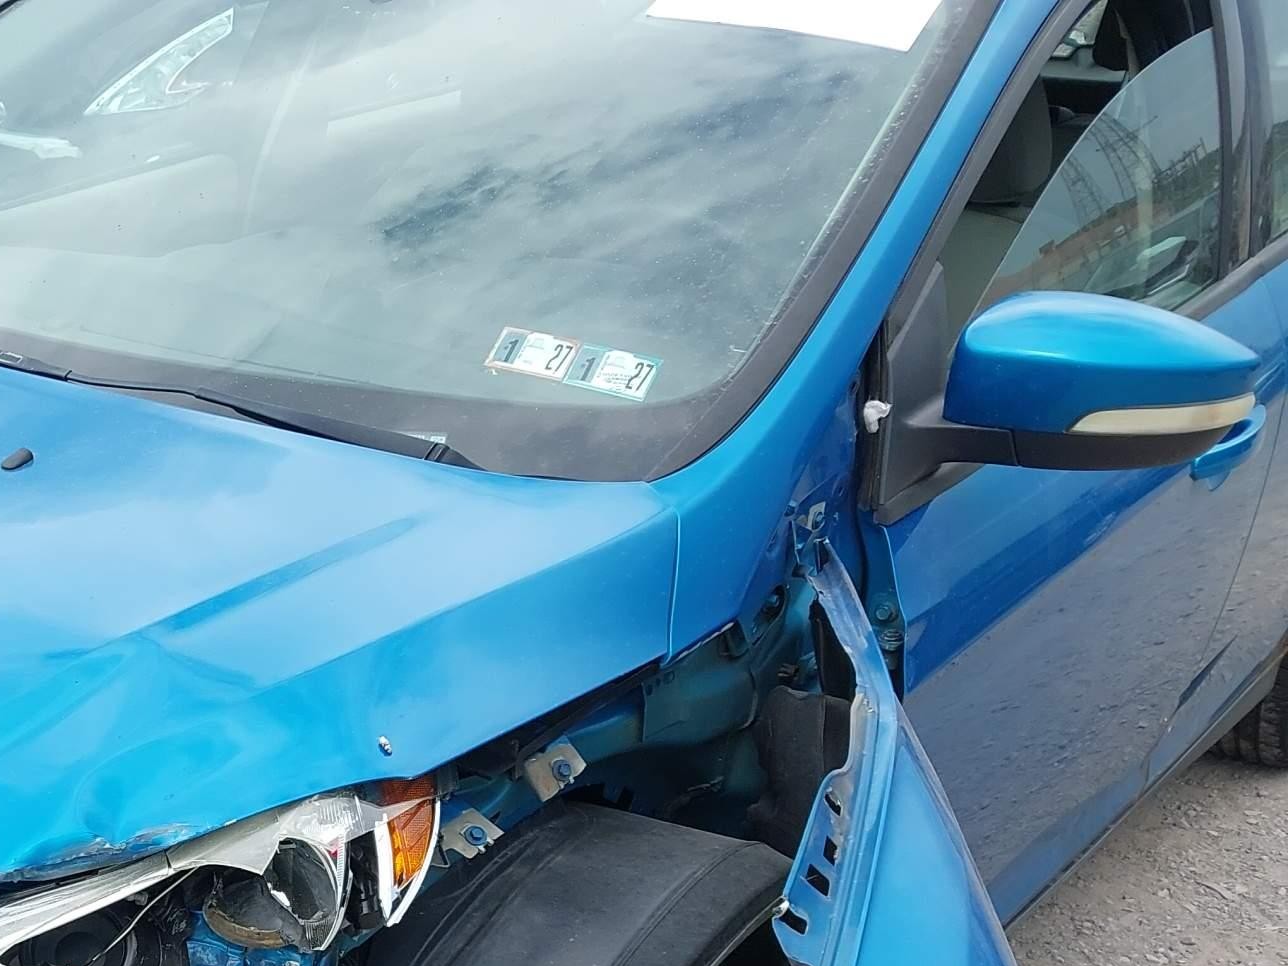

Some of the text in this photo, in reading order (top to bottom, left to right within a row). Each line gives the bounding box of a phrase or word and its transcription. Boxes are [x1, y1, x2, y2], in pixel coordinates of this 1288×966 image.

[503, 338, 574, 374] 1 27
[580, 356, 596, 382] 1
[625, 362, 655, 392] 27
